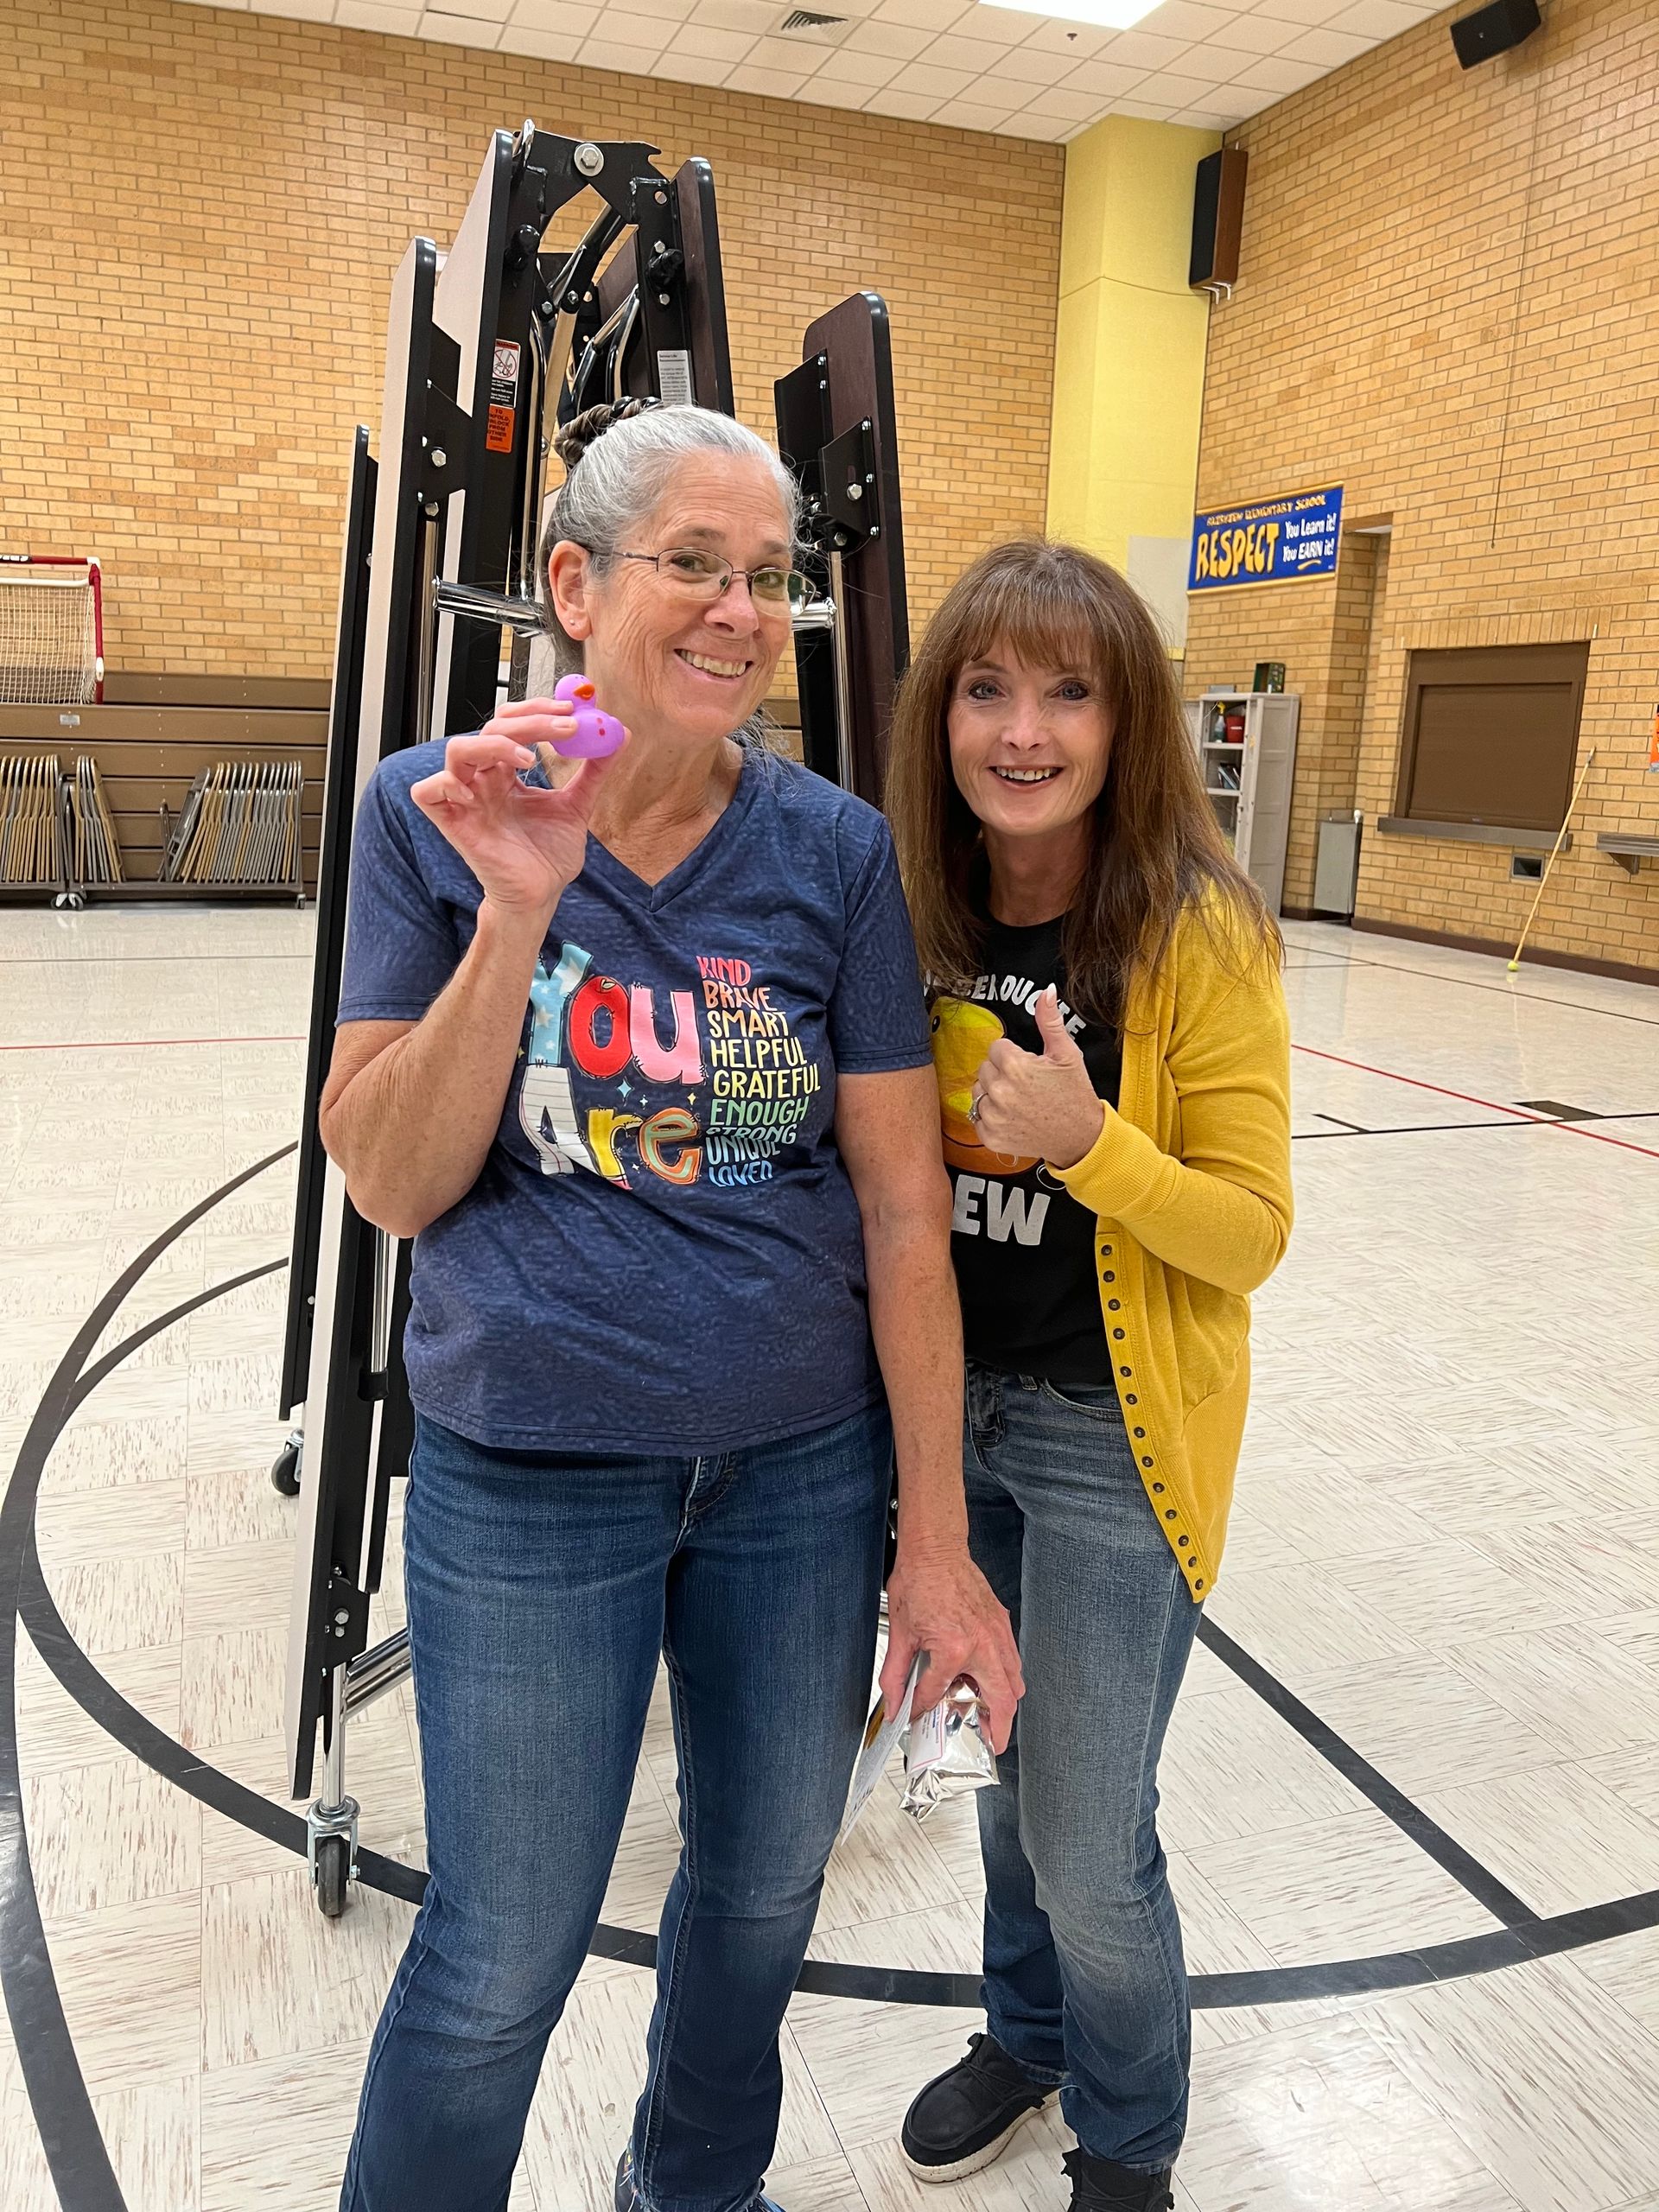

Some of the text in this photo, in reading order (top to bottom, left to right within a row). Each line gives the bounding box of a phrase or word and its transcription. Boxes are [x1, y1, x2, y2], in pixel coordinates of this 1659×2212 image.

[1245, 502, 1293, 520] ELEMENTARY
[1295, 494, 1326, 511] SCHOOL
[1285, 512, 1337, 539] You Learn it!
[1195, 522, 1280, 582] RESPECT
[1282, 537, 1335, 563] You EARN it!
[696, 956, 751, 986] KIND
[702, 980, 772, 1011] BRAVE
[529, 940, 706, 1085] You
[707, 1011, 789, 1039] SMART
[710, 1037, 808, 1069] HELPFUL
[713, 1064, 821, 1099] GRATEFUL
[710, 1096, 810, 1126] ENOUGH
[518, 1065, 703, 1190] Are
[709, 1160, 773, 1187] LOVED
